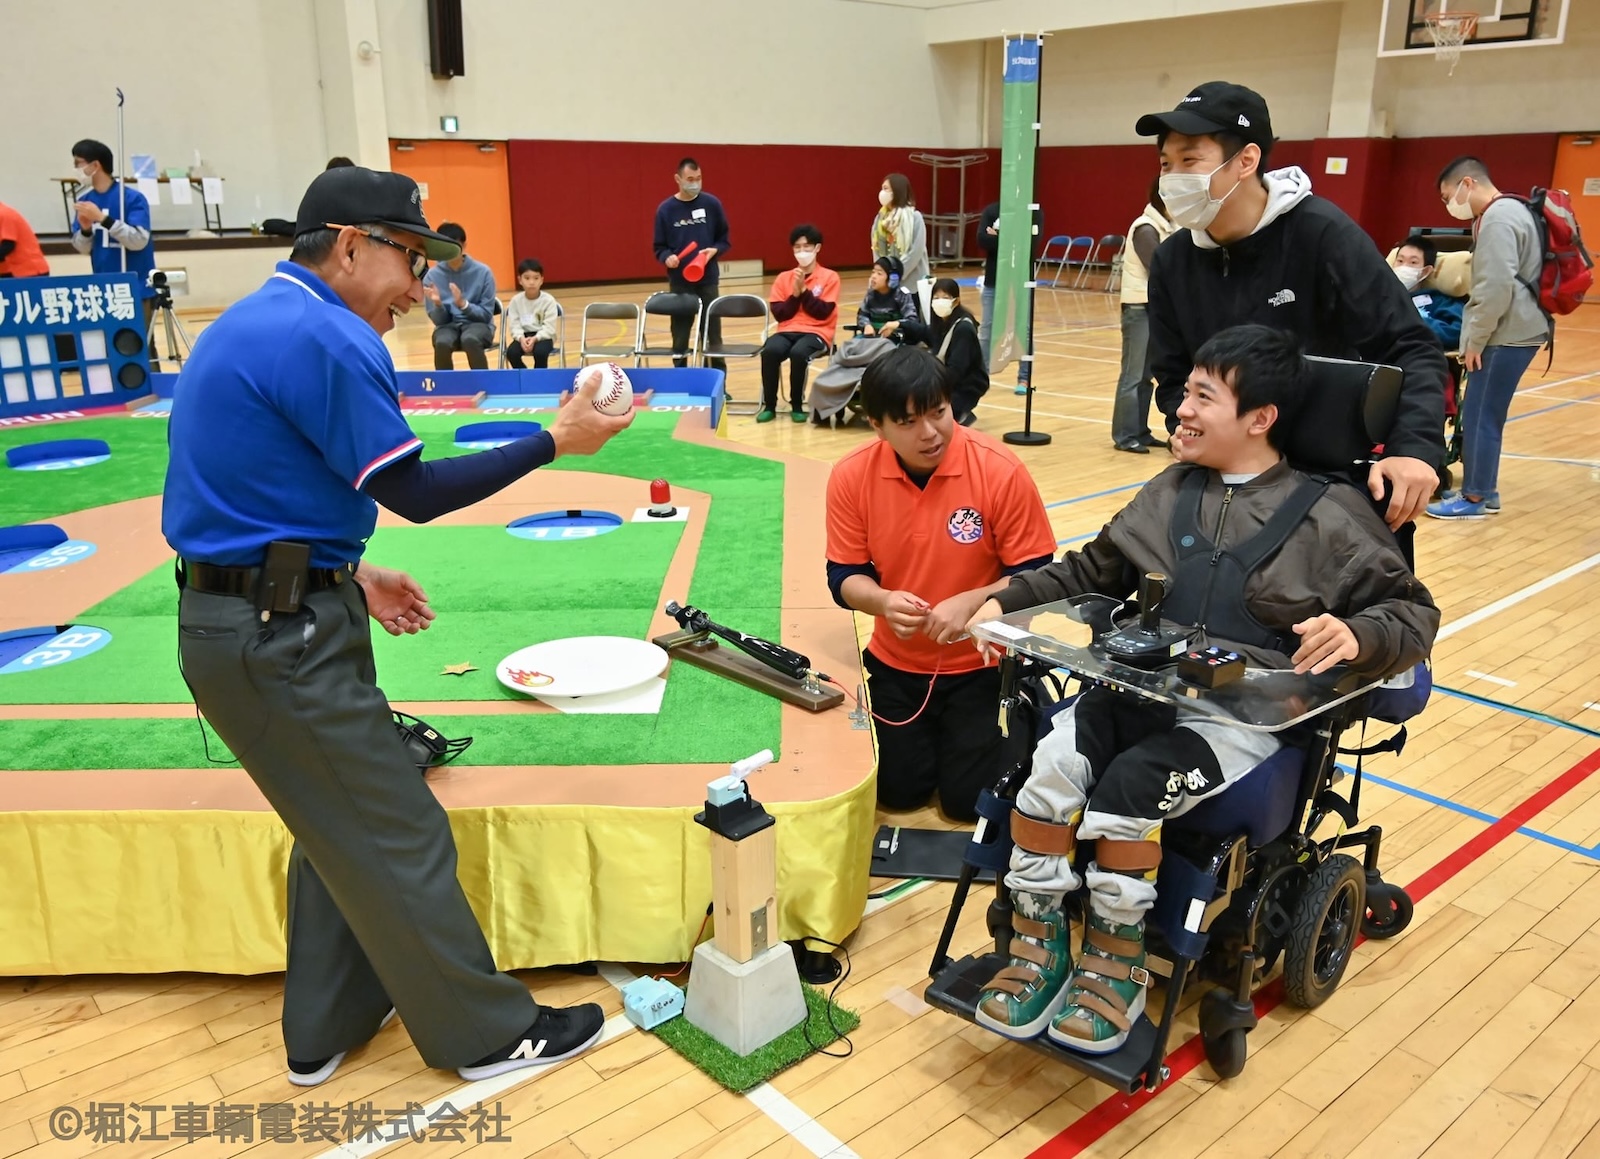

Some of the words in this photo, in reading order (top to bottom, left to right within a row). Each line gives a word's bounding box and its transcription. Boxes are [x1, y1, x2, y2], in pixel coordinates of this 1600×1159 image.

[482, 407, 545, 415] OUT
[651, 405, 712, 413] OUT
[528, 527, 598, 538] 1B
[28, 546, 89, 568] SS
[22, 632, 102, 665] 3B
[507, 1039, 548, 1060] N
